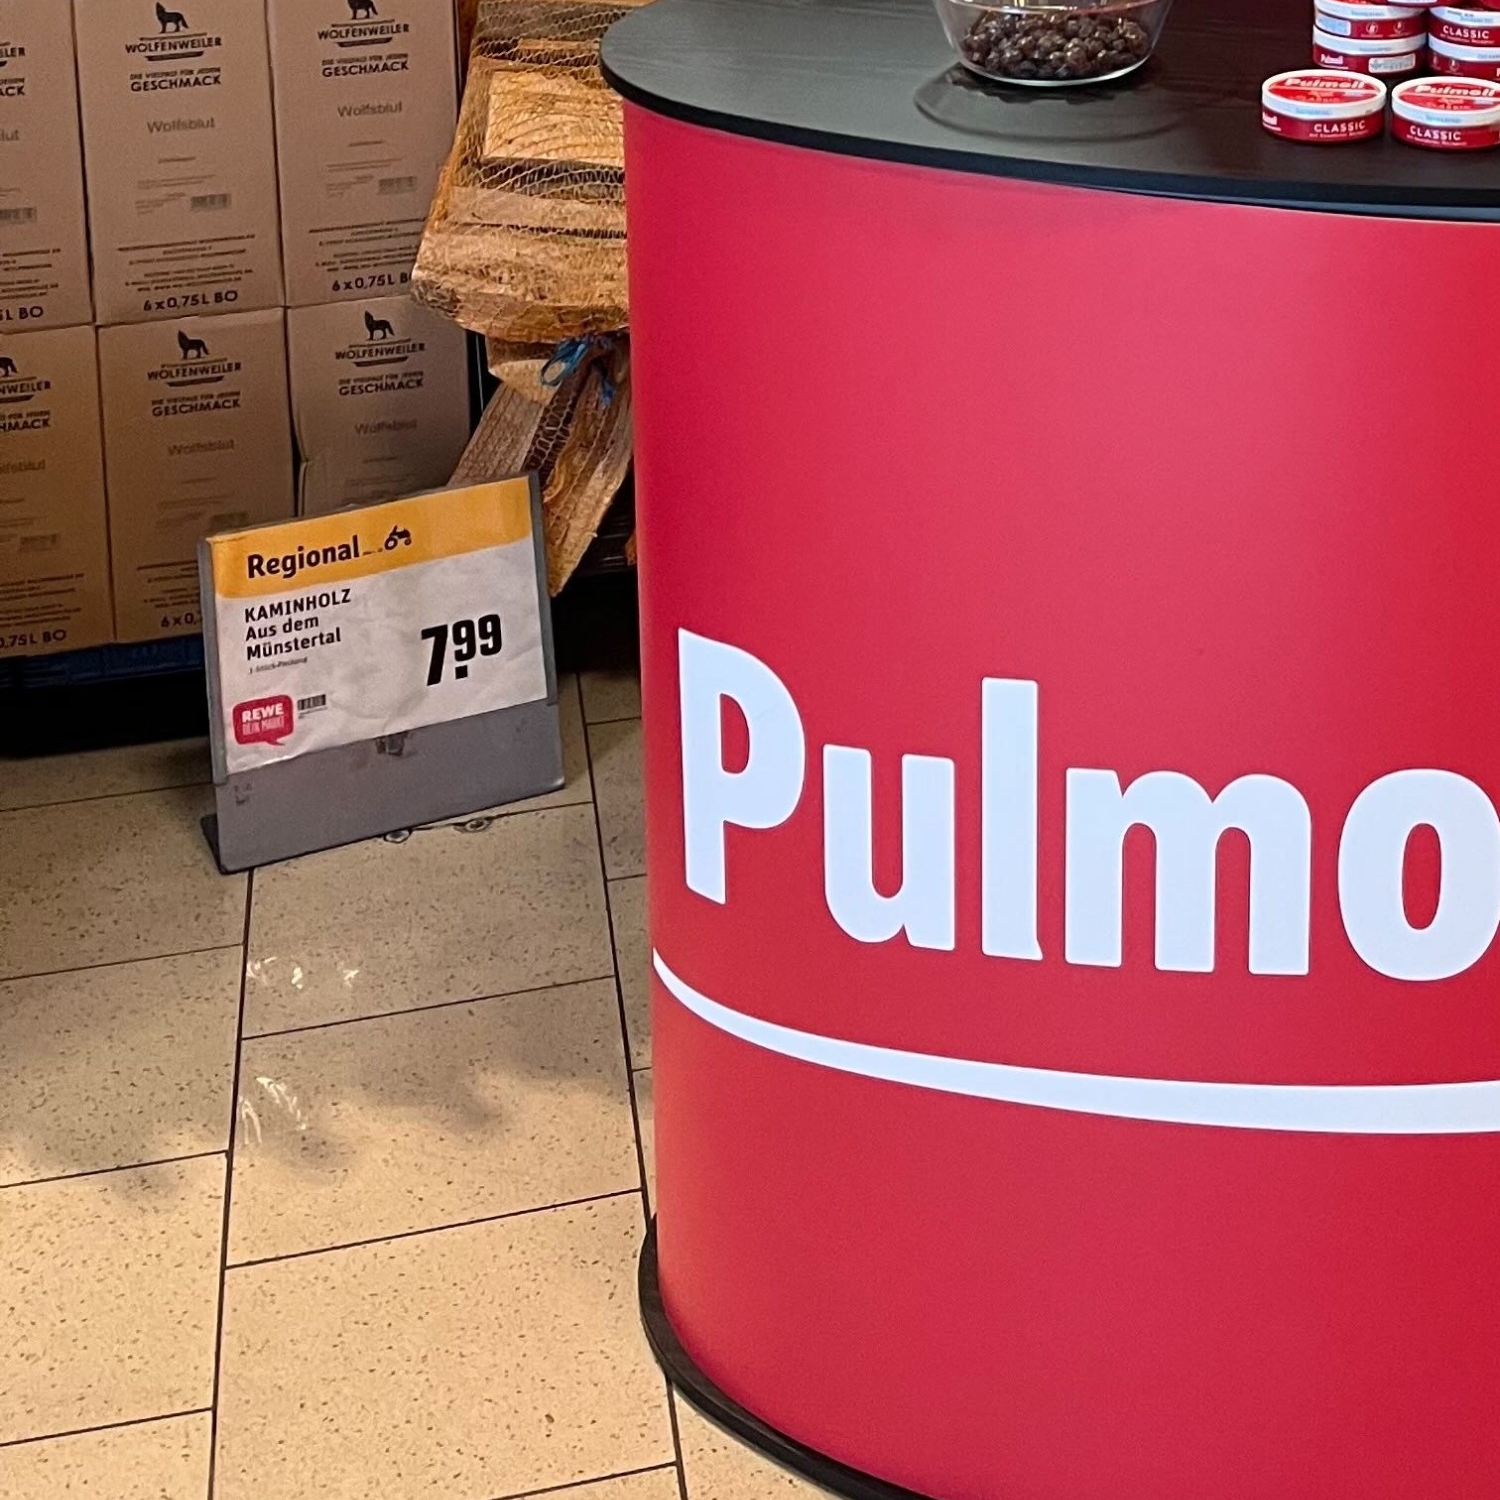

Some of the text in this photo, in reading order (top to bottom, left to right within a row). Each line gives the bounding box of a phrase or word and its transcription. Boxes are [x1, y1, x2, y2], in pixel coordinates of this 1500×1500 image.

[317, 23, 410, 40] WOLFENWEILER
[1442, 24, 1490, 40] CLASSIC
[125, 36, 223, 55] WOLFENWEILER
[321, 60, 409, 78] GESCHMACK
[130, 74, 222, 94] GESCHMACK
[1313, 119, 1366, 134] CLASSIC
[1409, 125, 1462, 142] CLASSIC
[338, 377, 424, 397] GESCHMACK
[151, 397, 241, 418] GESCHMACK
[247, 536, 360, 579] Regional
[245, 589, 352, 623] KAMINHOLZ
[245, 614, 320, 642] Aus dem
[246, 627, 342, 661] Münstertal
[242, 703, 284, 723] REWE
